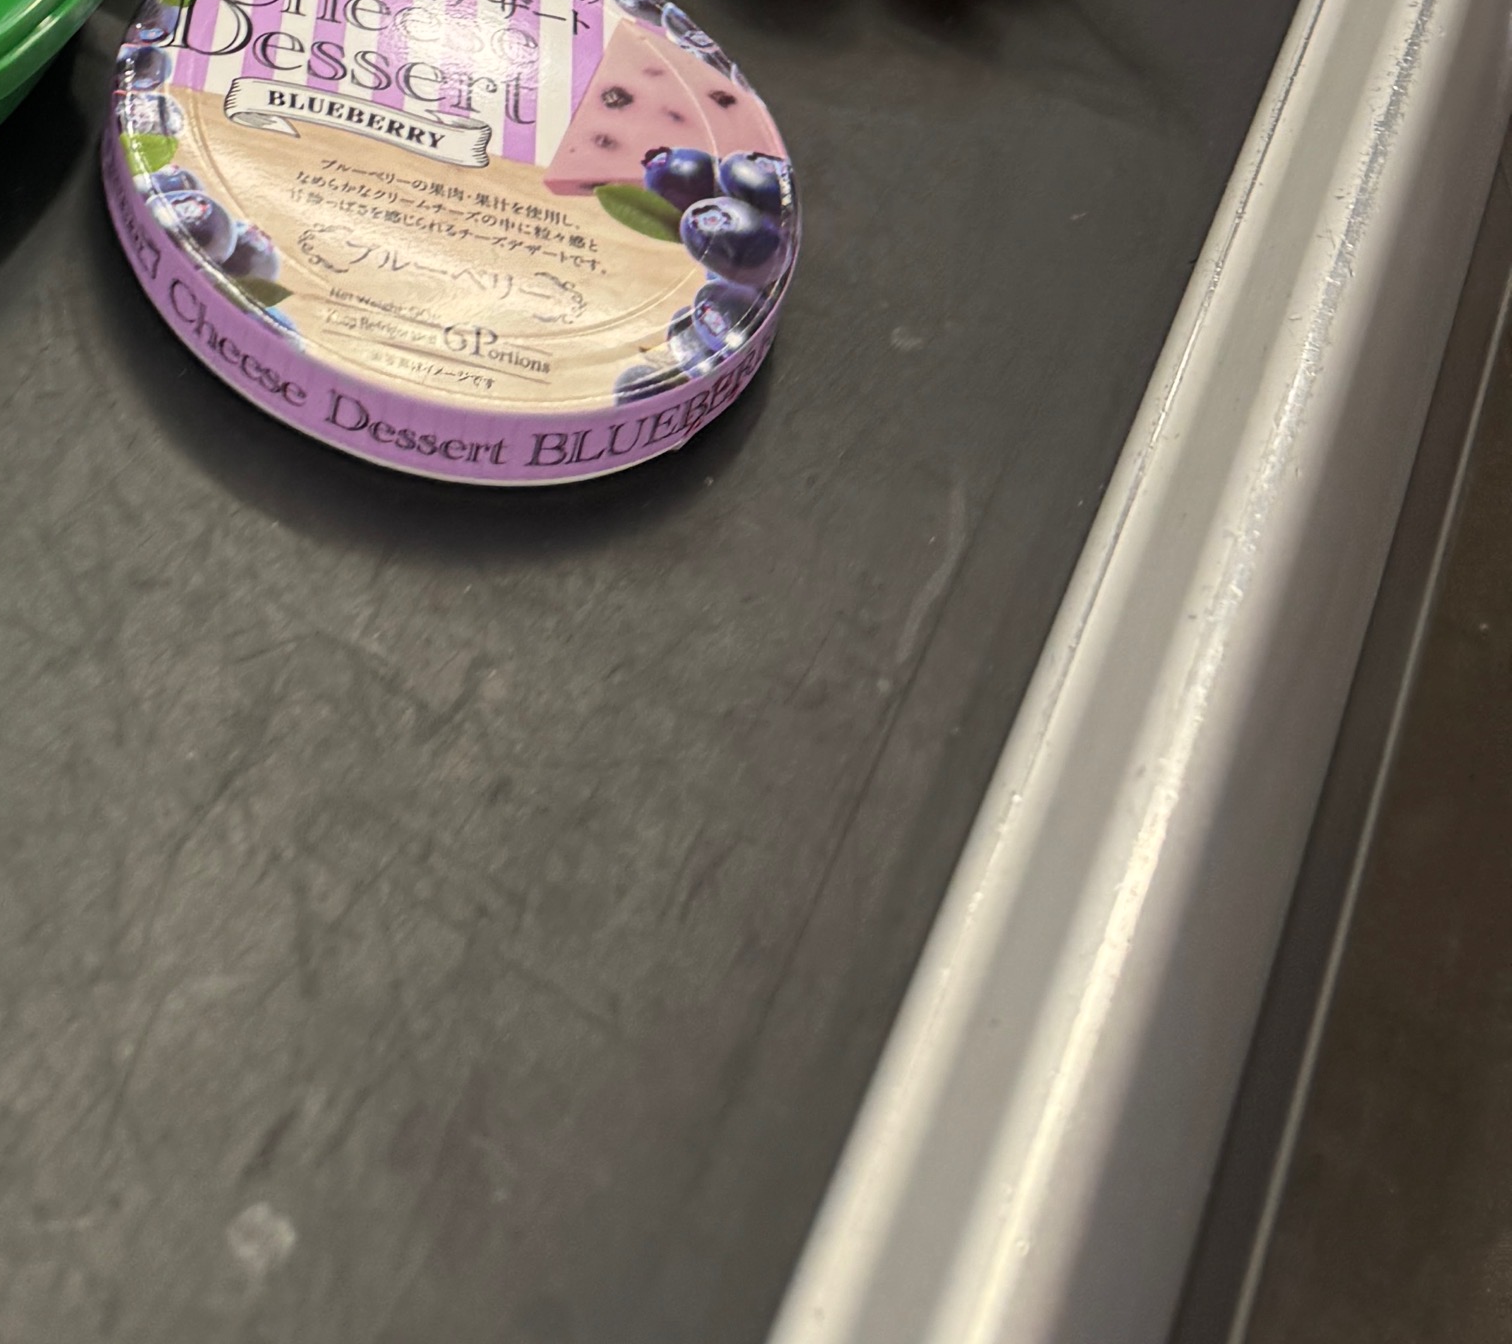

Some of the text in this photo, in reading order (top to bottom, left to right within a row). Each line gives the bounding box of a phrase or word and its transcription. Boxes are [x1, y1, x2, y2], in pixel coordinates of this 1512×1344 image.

[268, 89, 445, 150] BLUEBERRY
[345, 239, 552, 300] ブルーベリー
[169, 277, 308, 408] Cheese
[324, 388, 508, 466] Dessert
